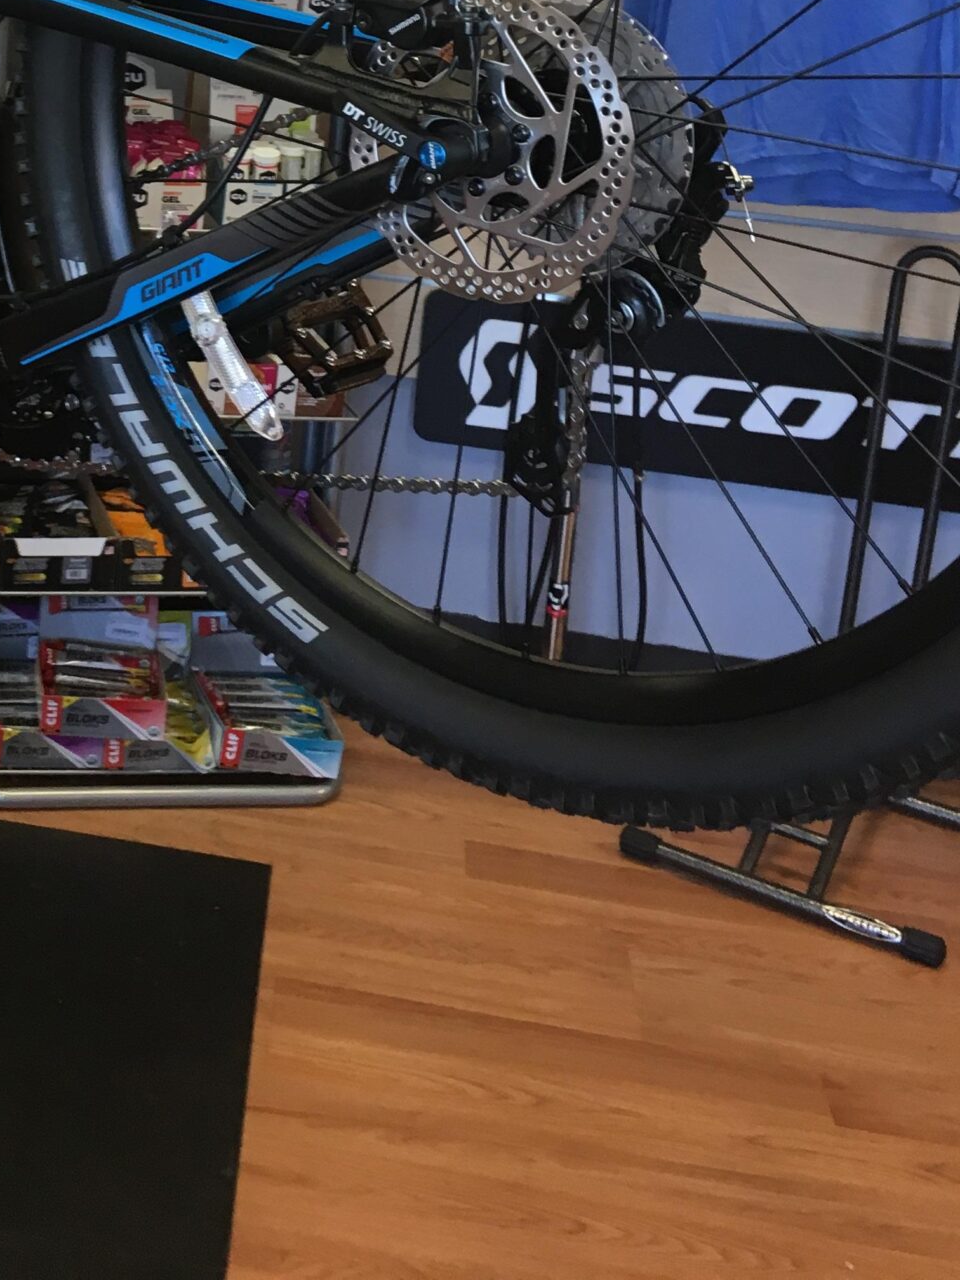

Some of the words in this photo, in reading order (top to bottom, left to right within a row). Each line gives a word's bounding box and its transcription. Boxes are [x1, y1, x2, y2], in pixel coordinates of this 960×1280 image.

[131, 108, 151, 116] GEL
[342, 101, 366, 121] DT
[363, 116, 408, 148] SWISS
[141, 257, 205, 303] GIANT
[45, 699, 60, 726] CLIF
[66, 713, 110, 725] BLOKS
[6, 746, 50, 758] BLOKS
[107, 739, 121, 764] CLIF
[128, 748, 170, 760] BLOKS
[225, 732, 241, 761] CLIF
[244, 749, 289, 762] BLOKS
